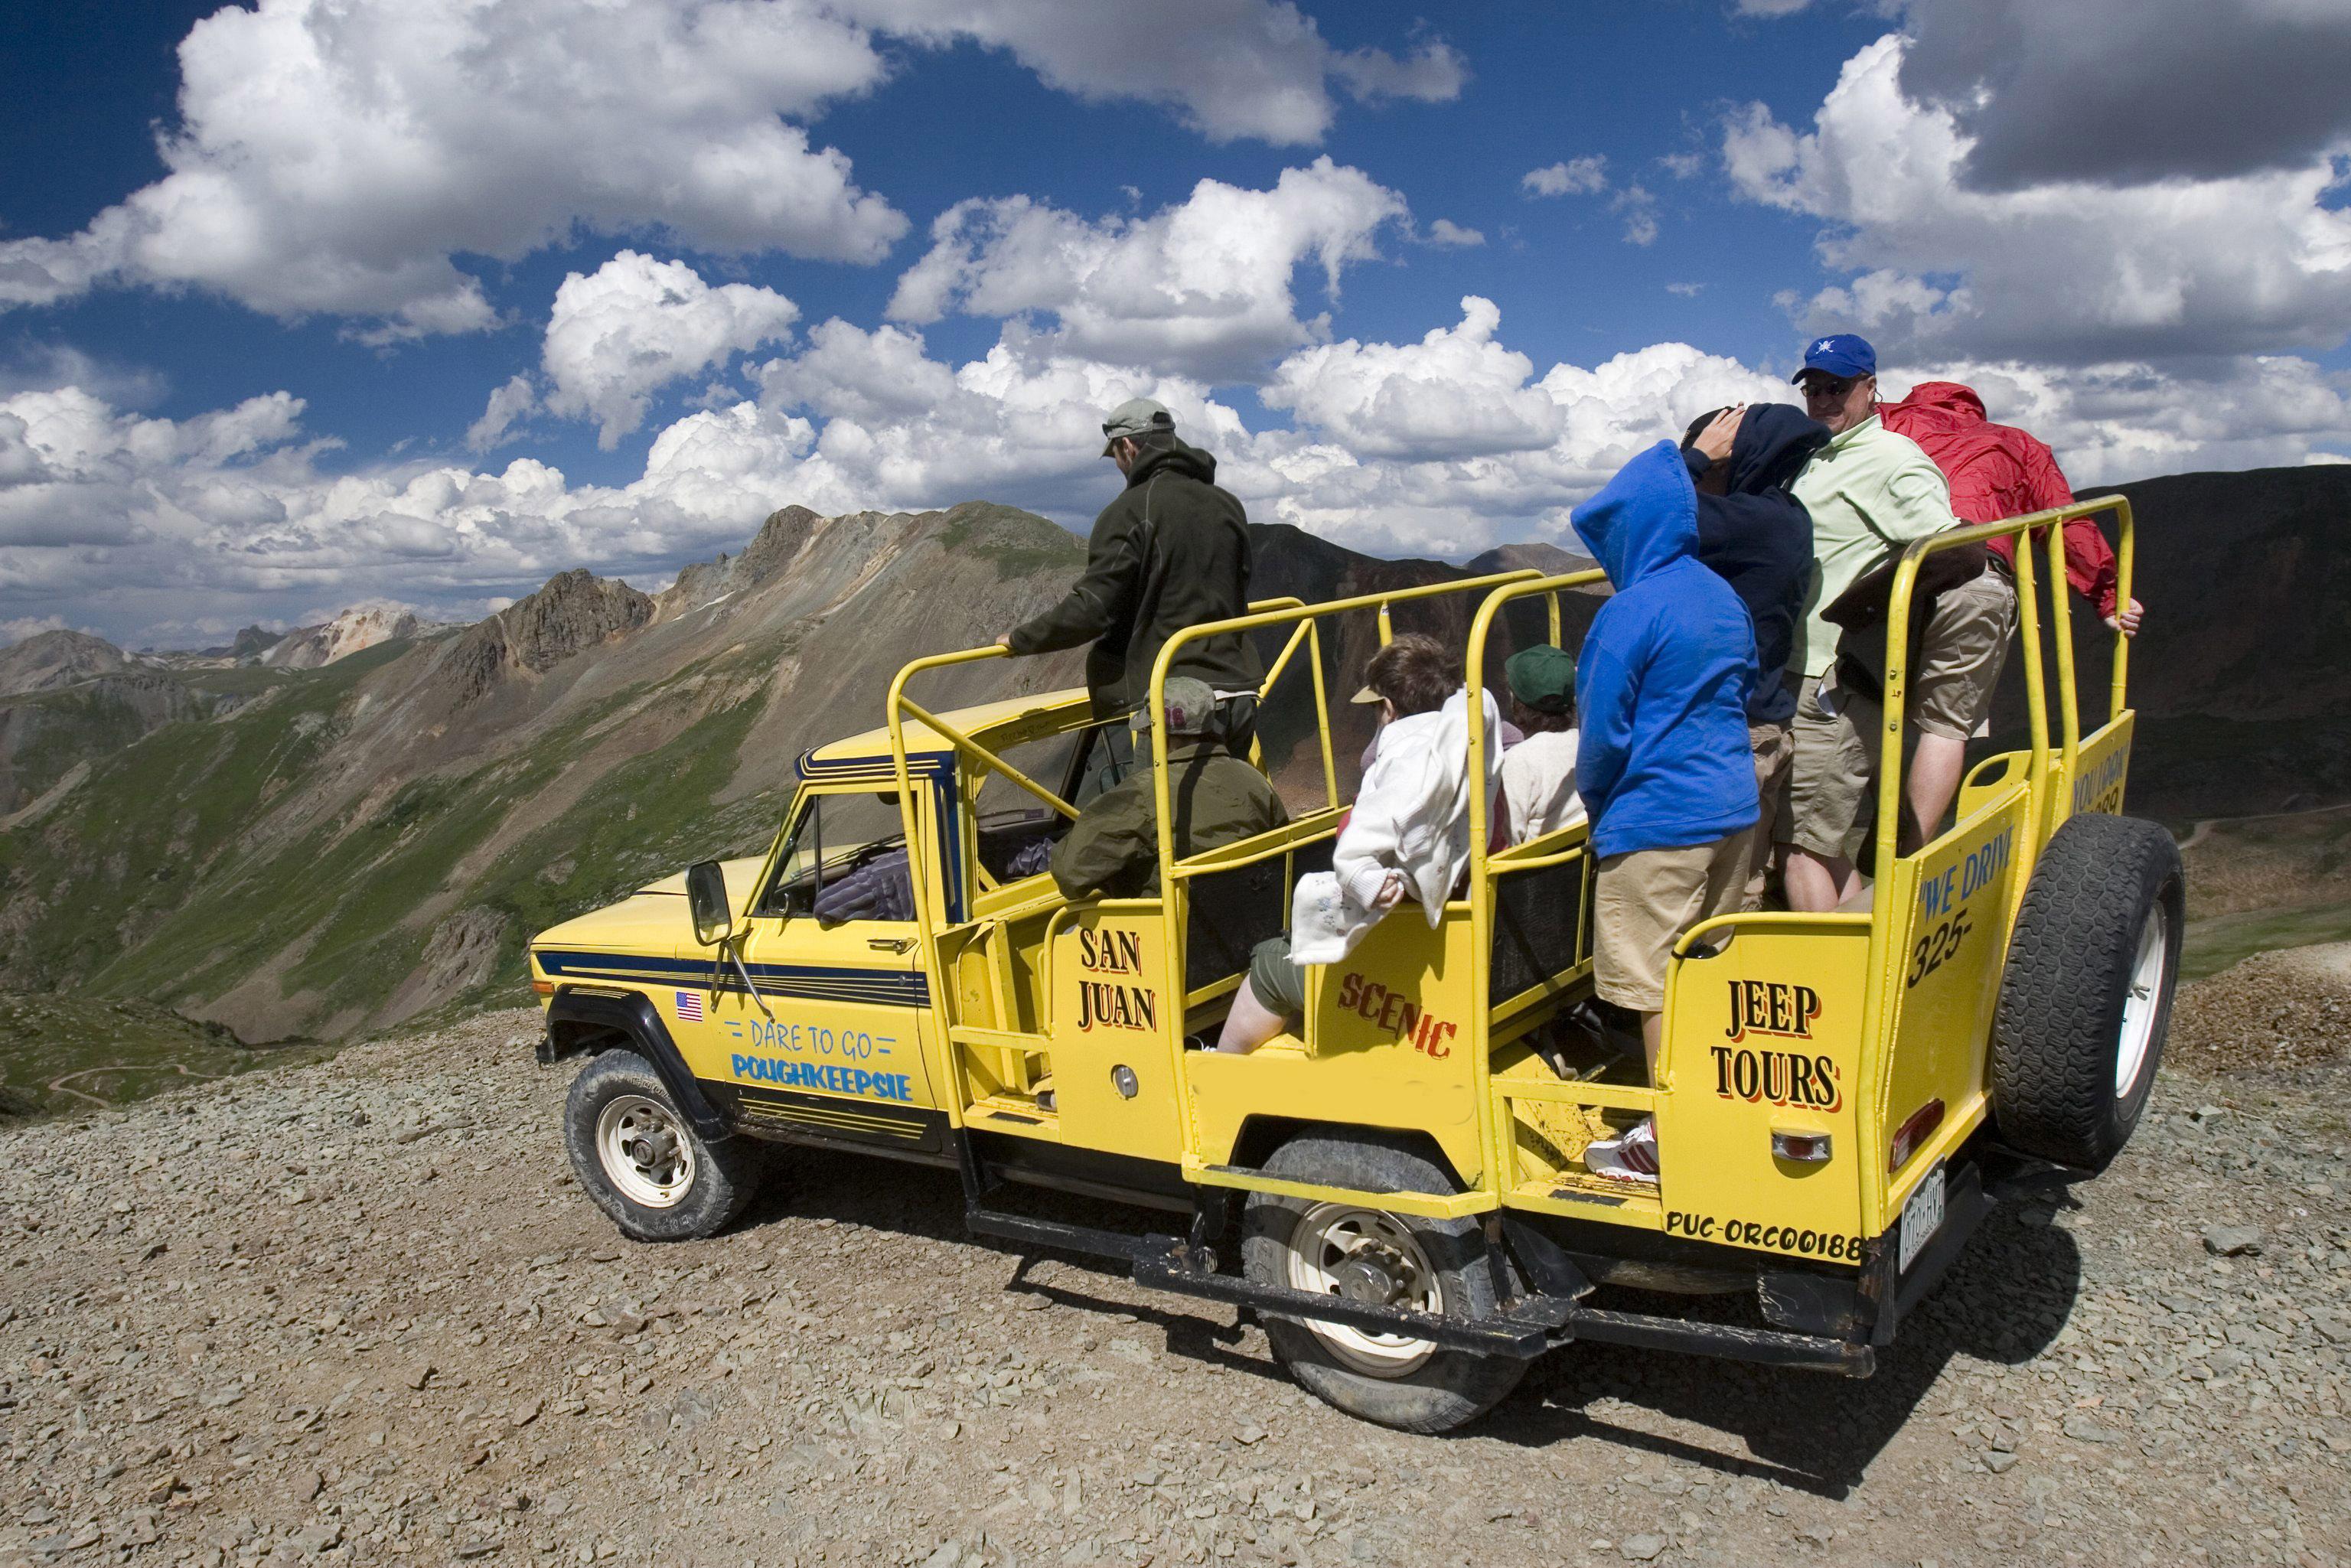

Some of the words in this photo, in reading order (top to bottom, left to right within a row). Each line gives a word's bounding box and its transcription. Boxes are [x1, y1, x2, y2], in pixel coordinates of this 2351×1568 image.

[1961, 826, 2014, 901] DRIVE
[1080, 927, 1142, 977] SAN
[1078, 980, 1157, 1033] JUAN
[1338, 972, 1458, 1061] SCENIC
[1725, 980, 1822, 1043] JEEP
[750, 1019, 802, 1052] DARE
[808, 1026, 833, 1055] TO
[842, 1031, 872, 1061] GO
[731, 1054, 914, 1102] POUGHKEEPSIE
[1710, 1046, 1843, 1113] TOURS
